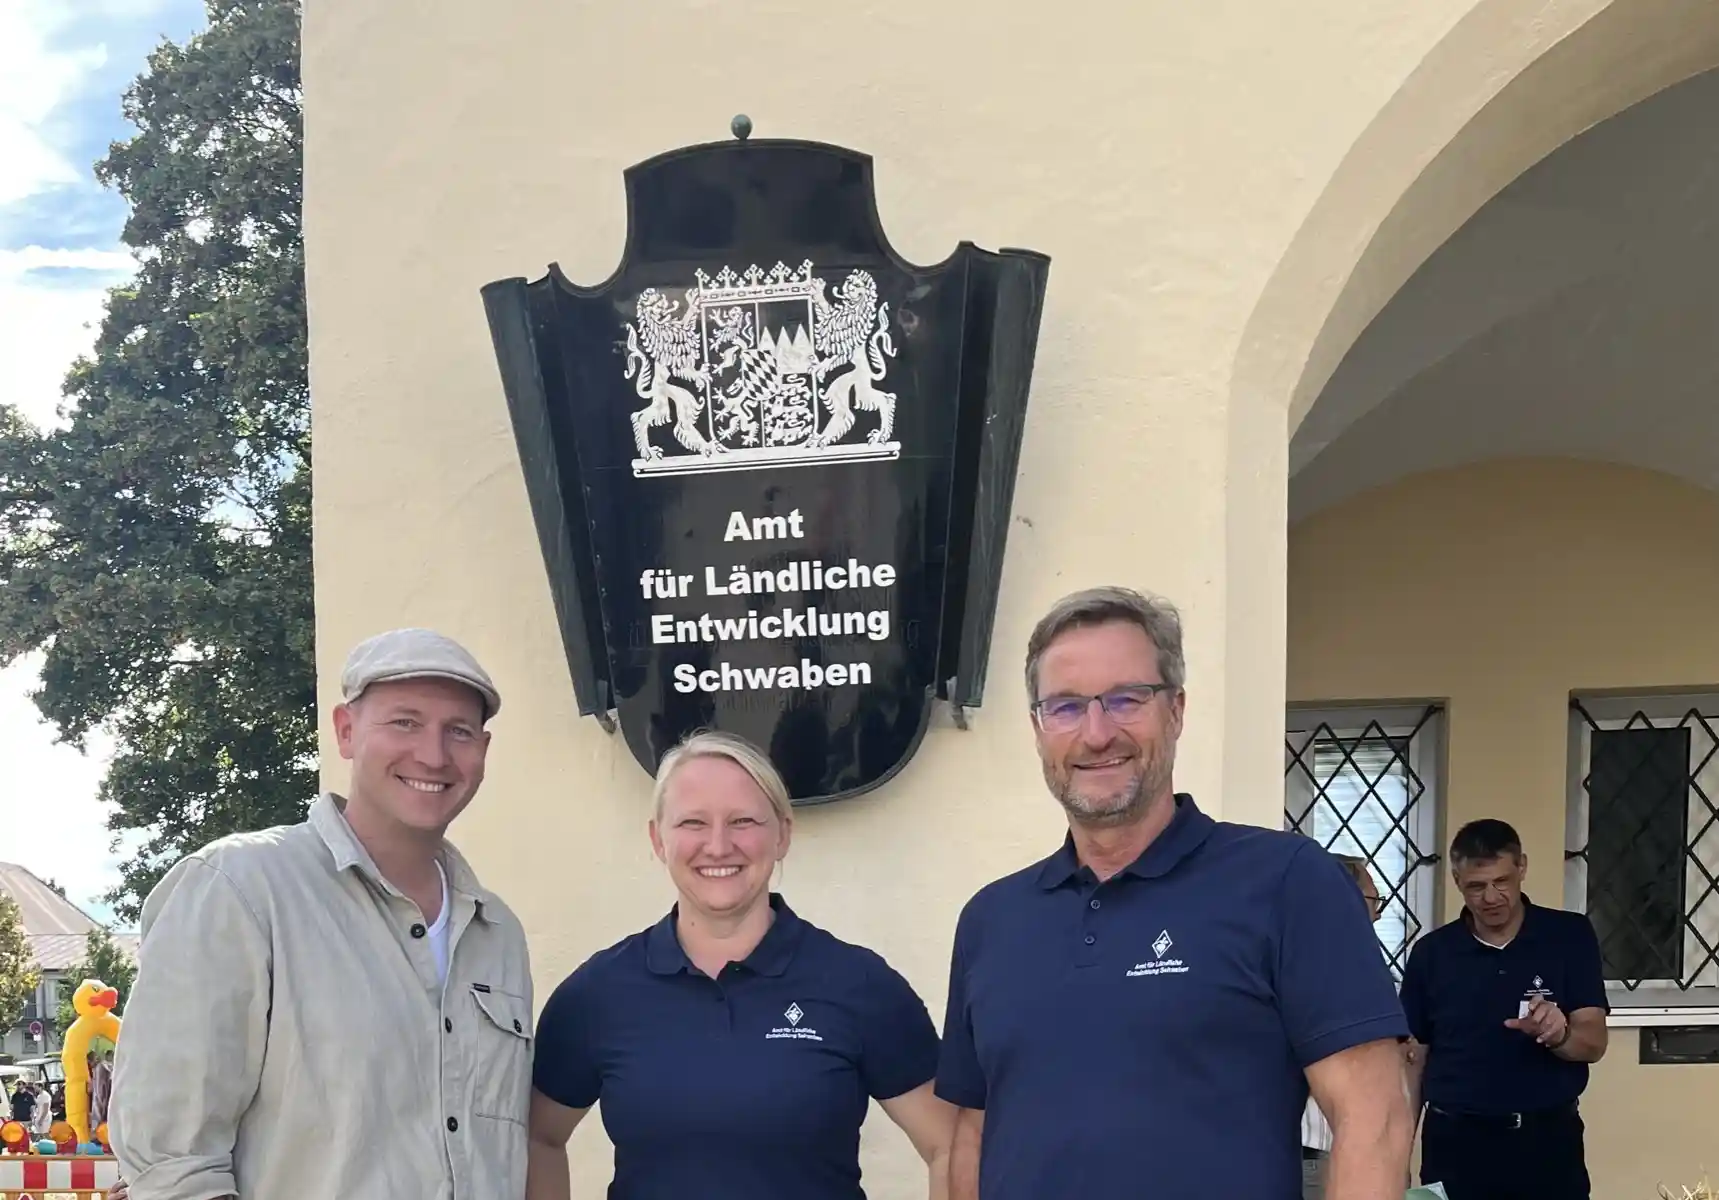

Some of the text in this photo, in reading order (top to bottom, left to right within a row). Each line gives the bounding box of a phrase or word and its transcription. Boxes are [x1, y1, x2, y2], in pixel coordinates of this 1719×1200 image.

[724, 509, 804, 541] Amt
[640, 559, 896, 598] für Ländliche
[652, 607, 889, 643] Entwicklung
[674, 659, 871, 692] Schwaben
